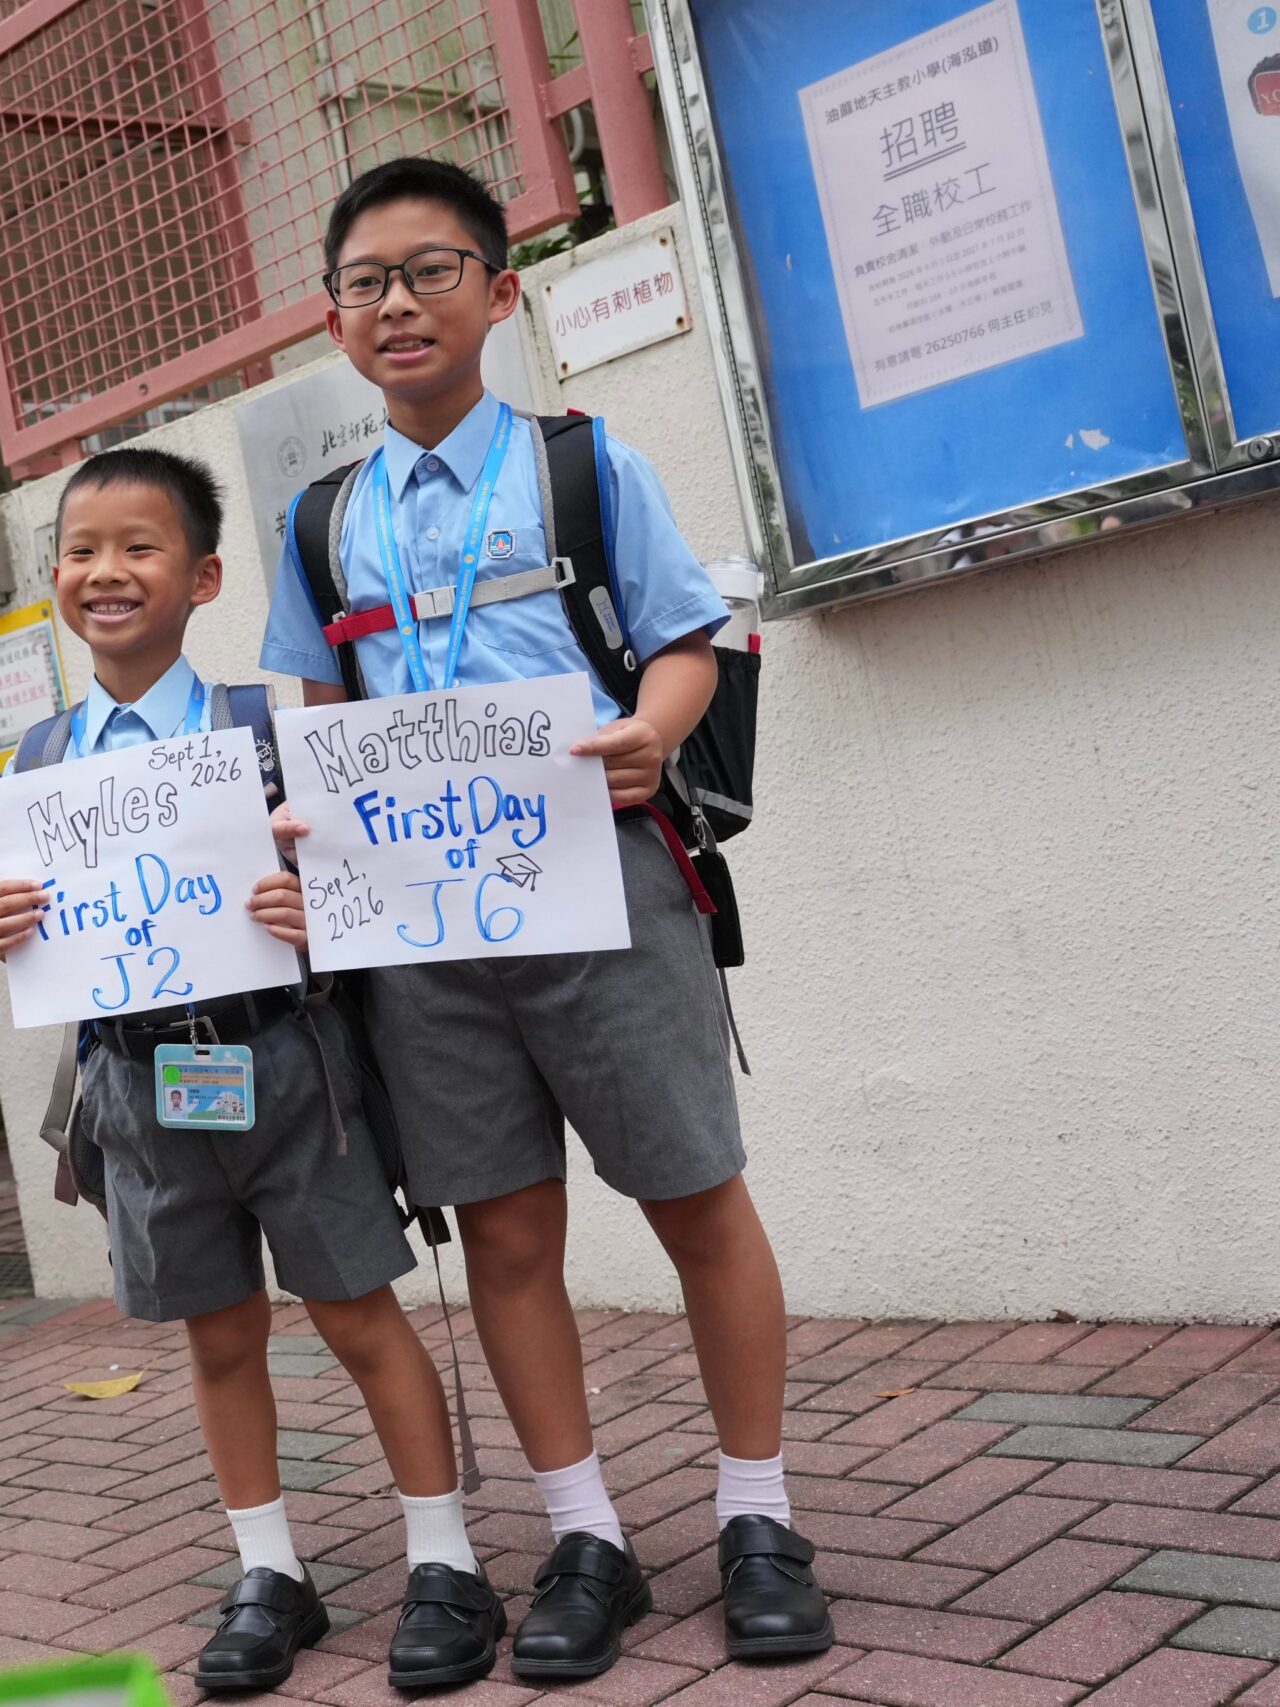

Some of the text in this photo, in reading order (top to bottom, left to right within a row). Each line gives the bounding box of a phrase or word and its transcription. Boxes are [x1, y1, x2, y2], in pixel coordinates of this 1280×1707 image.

[879, 101, 959, 168] 招聘
[872, 162, 997, 237] 全職校工
[556, 272, 674, 337] 小心有刺植物
[925, 324, 985, 355] 26250766
[148, 735, 222, 772] Sept 1,
[190, 757, 242, 787] 2026
[304, 699, 551, 793] Matthias
[26, 776, 178, 868] Myles
[353, 776, 546, 848] First Day
[445, 838, 481, 868] of
[32, 853, 222, 941] First Day
[308, 859, 366, 909] Sep 1,
[125, 919, 157, 947] of
[328, 887, 384, 941] 2026
